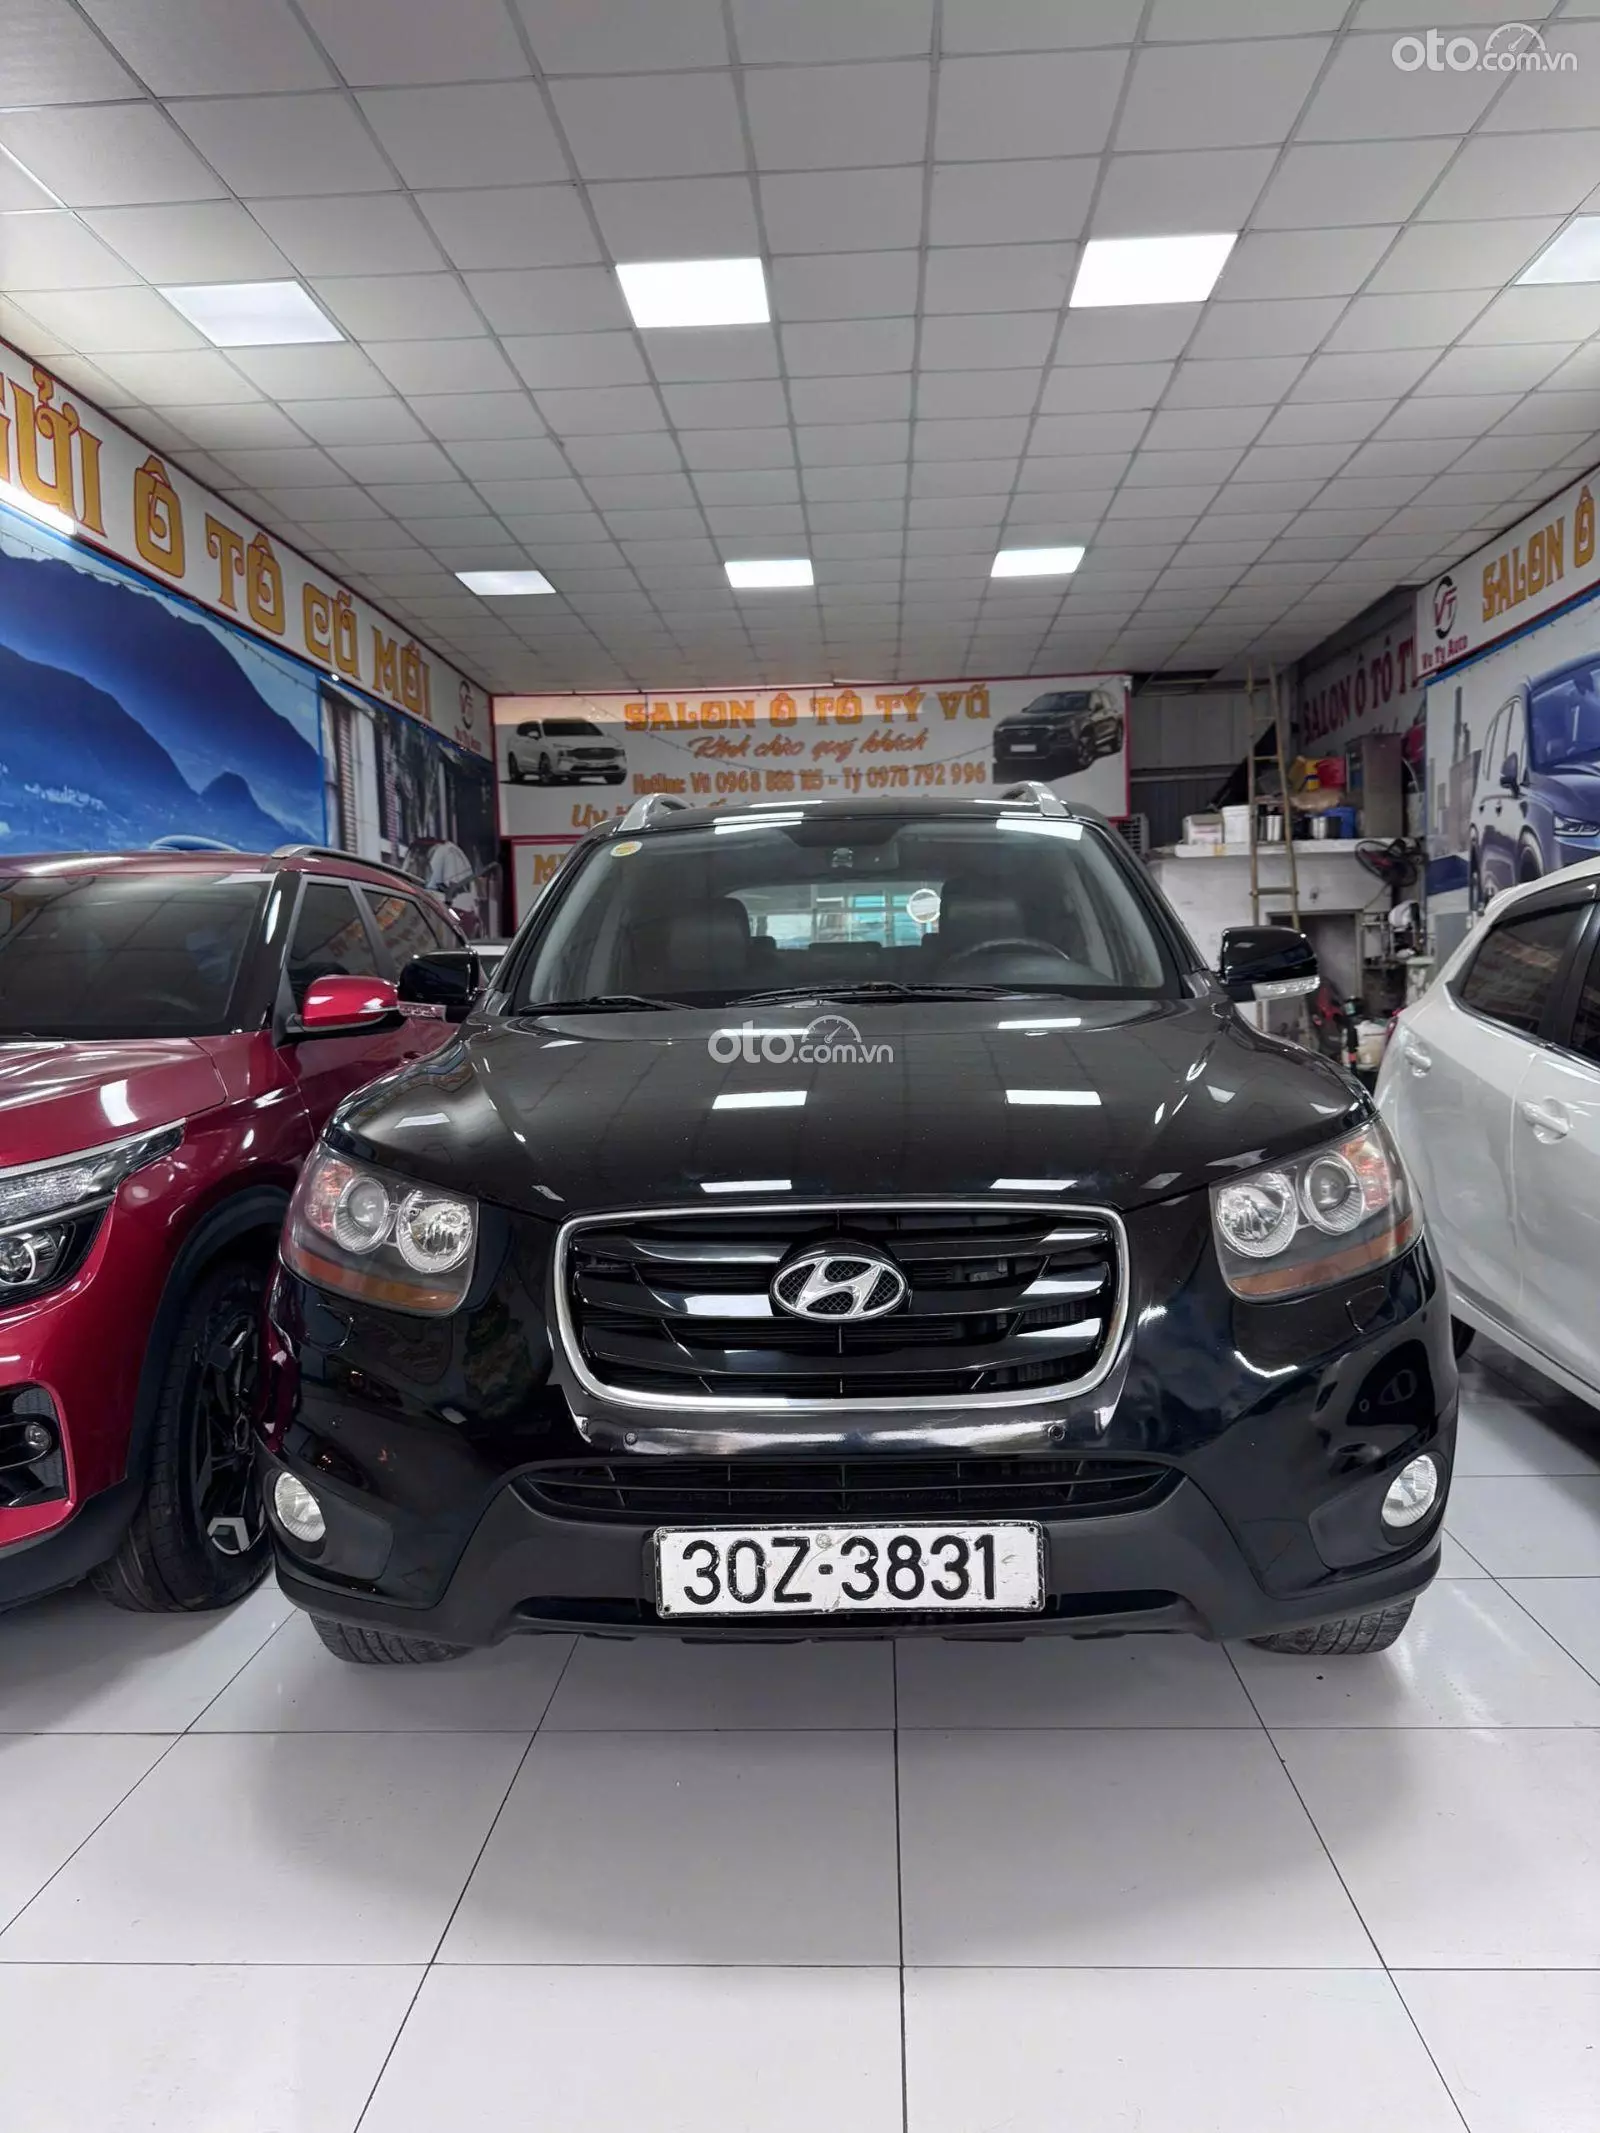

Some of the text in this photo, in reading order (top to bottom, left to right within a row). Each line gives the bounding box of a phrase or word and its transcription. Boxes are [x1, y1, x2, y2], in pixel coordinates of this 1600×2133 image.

[134, 455, 185, 578] Ô
[205, 512, 286, 636] TÔ
[303, 582, 362, 682] CŨ
[1482, 484, 1595, 623] SALON Ô
[624, 700, 757, 731] SALON
[769, 692, 798, 727] Ô
[810, 688, 863, 726] TÔ
[936, 683, 990, 720] VŨ
[1304, 672, 1351, 745] SALON
[1354, 653, 1367, 717] Ô
[1371, 635, 1393, 709] TÔ
[682, 1533, 997, 1605] 30Z-3831
